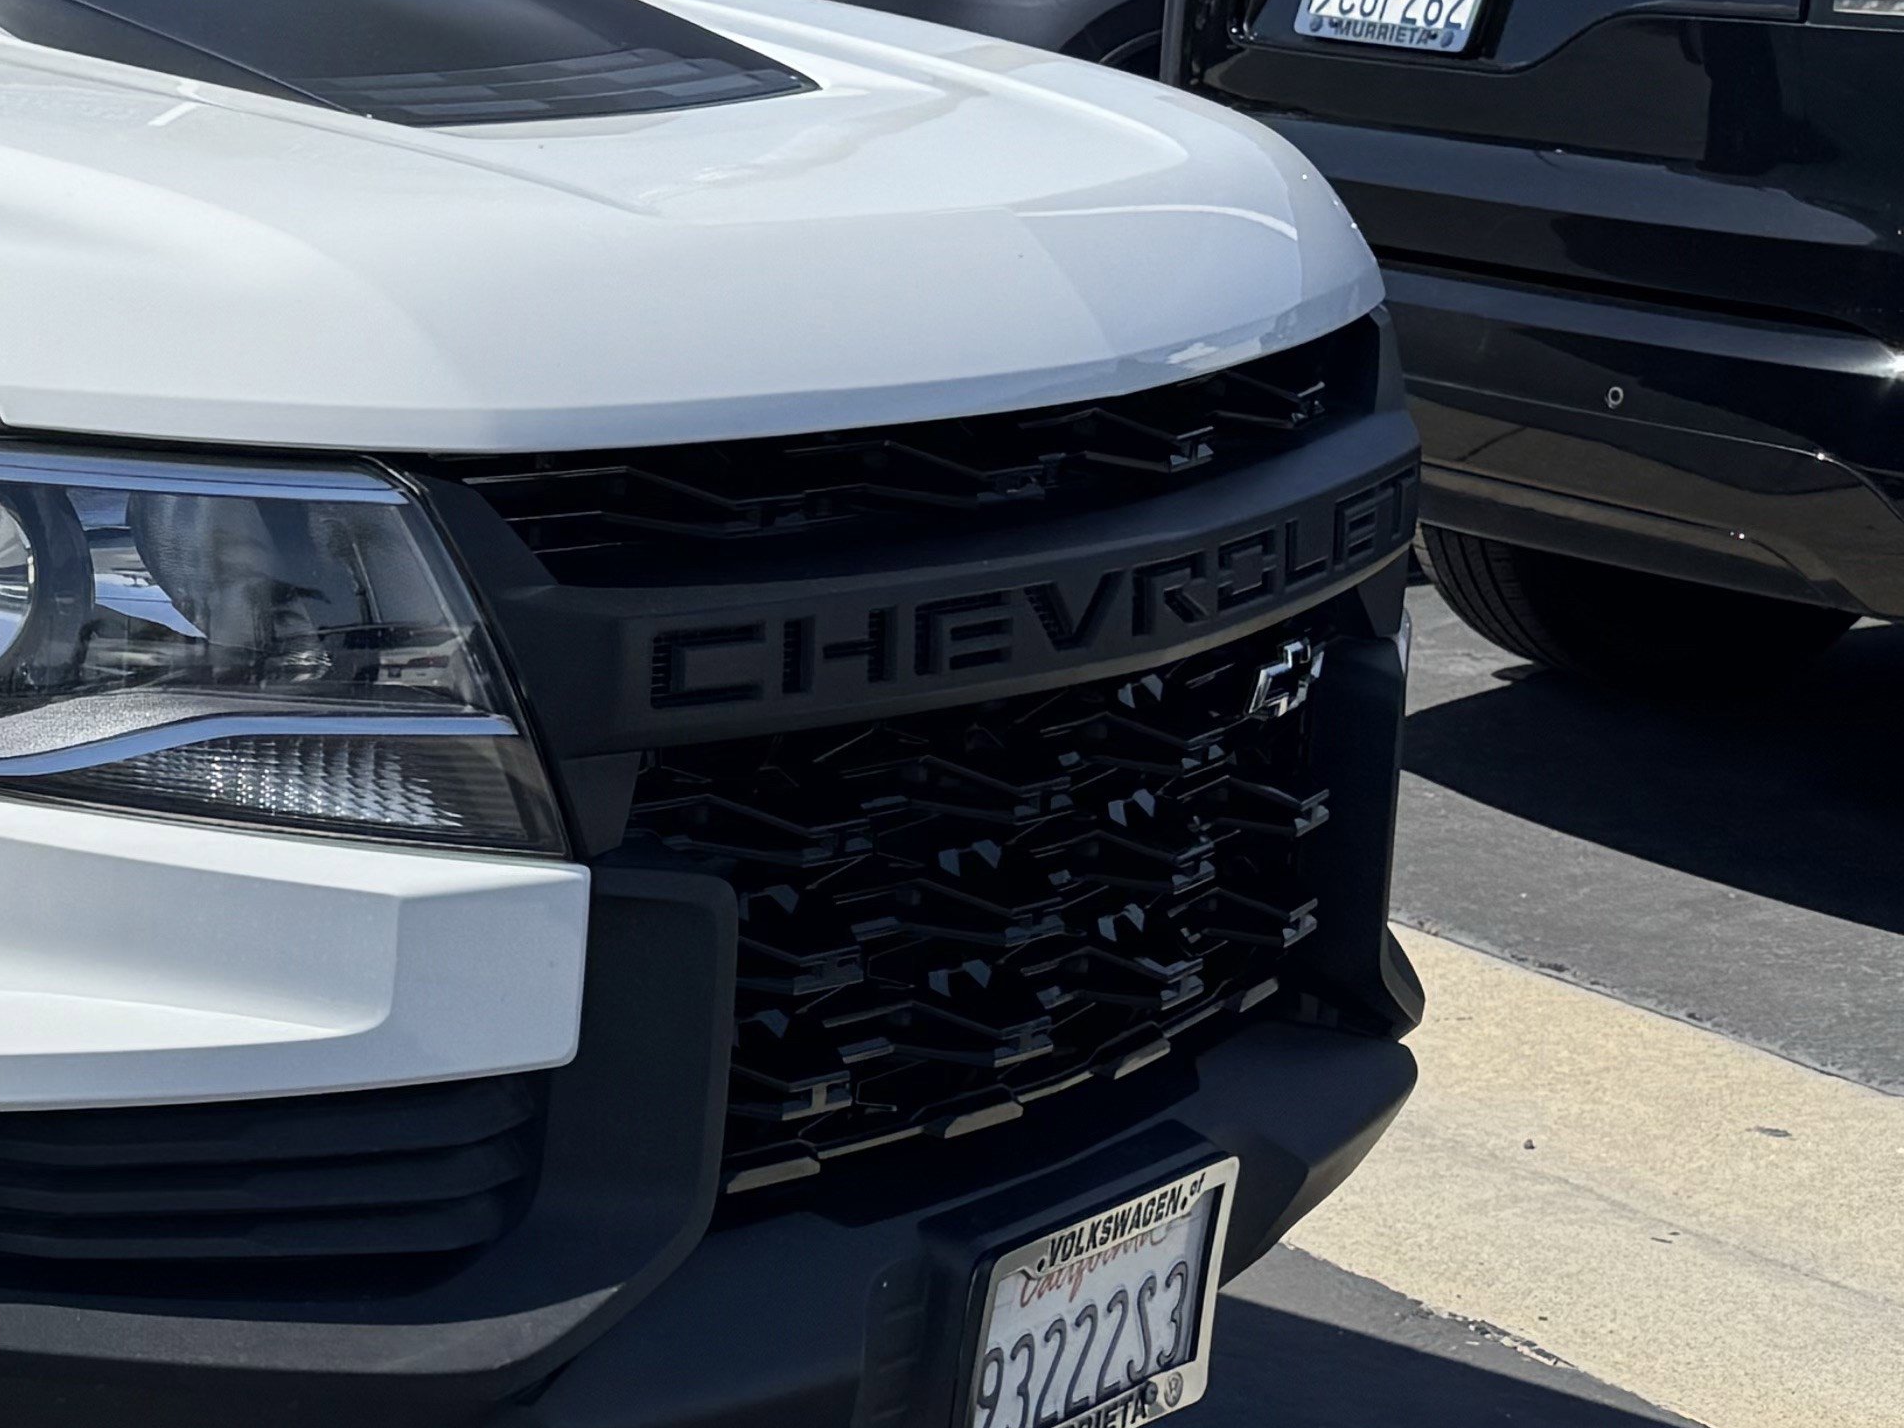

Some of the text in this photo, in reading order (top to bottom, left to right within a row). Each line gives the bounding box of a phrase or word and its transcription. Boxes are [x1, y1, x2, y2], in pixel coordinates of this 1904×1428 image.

[1334, 18, 1431, 46] MURRIETA
[649, 463, 1416, 710] CHEVROLET
[1047, 1183, 1183, 1269] VOLKSWAGEN
